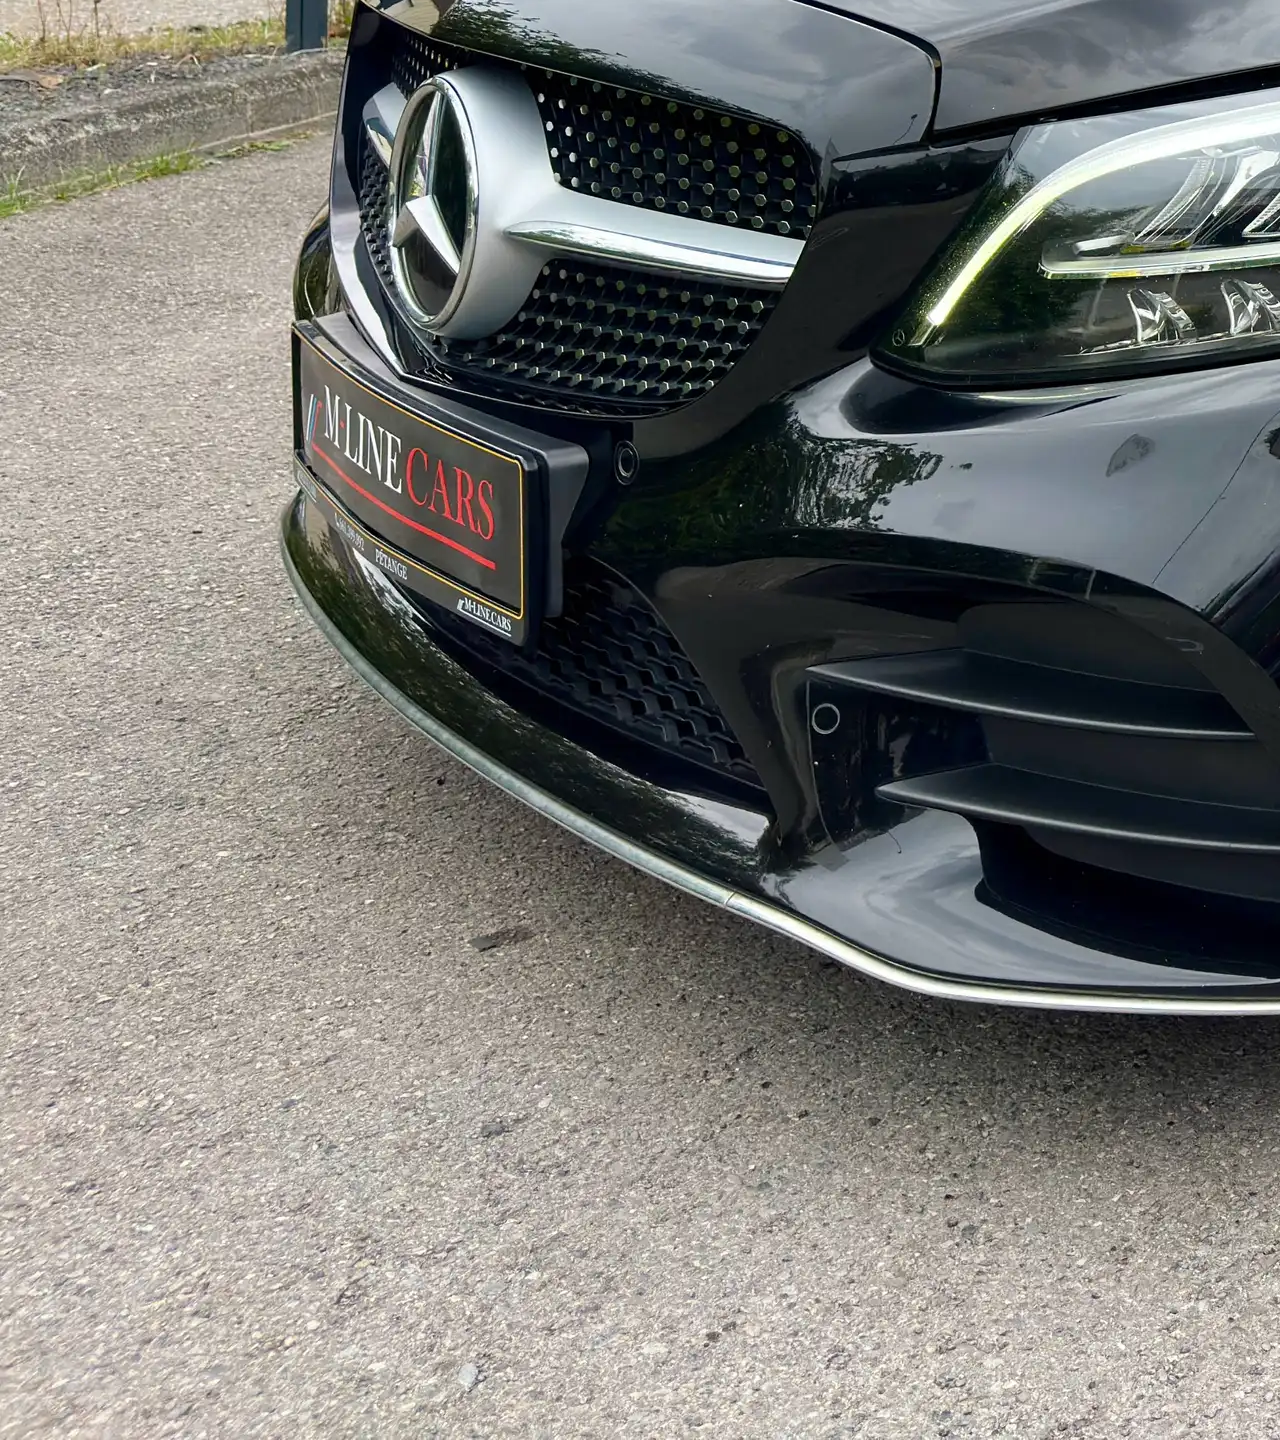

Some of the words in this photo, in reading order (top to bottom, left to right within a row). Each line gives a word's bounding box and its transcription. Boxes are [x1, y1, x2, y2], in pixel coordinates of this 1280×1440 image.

[324, 385, 403, 495] M-LINE
[406, 447, 495, 541] CARS
[375, 547, 408, 581] PÉTANGE
[491, 611, 512, 632] CARS
